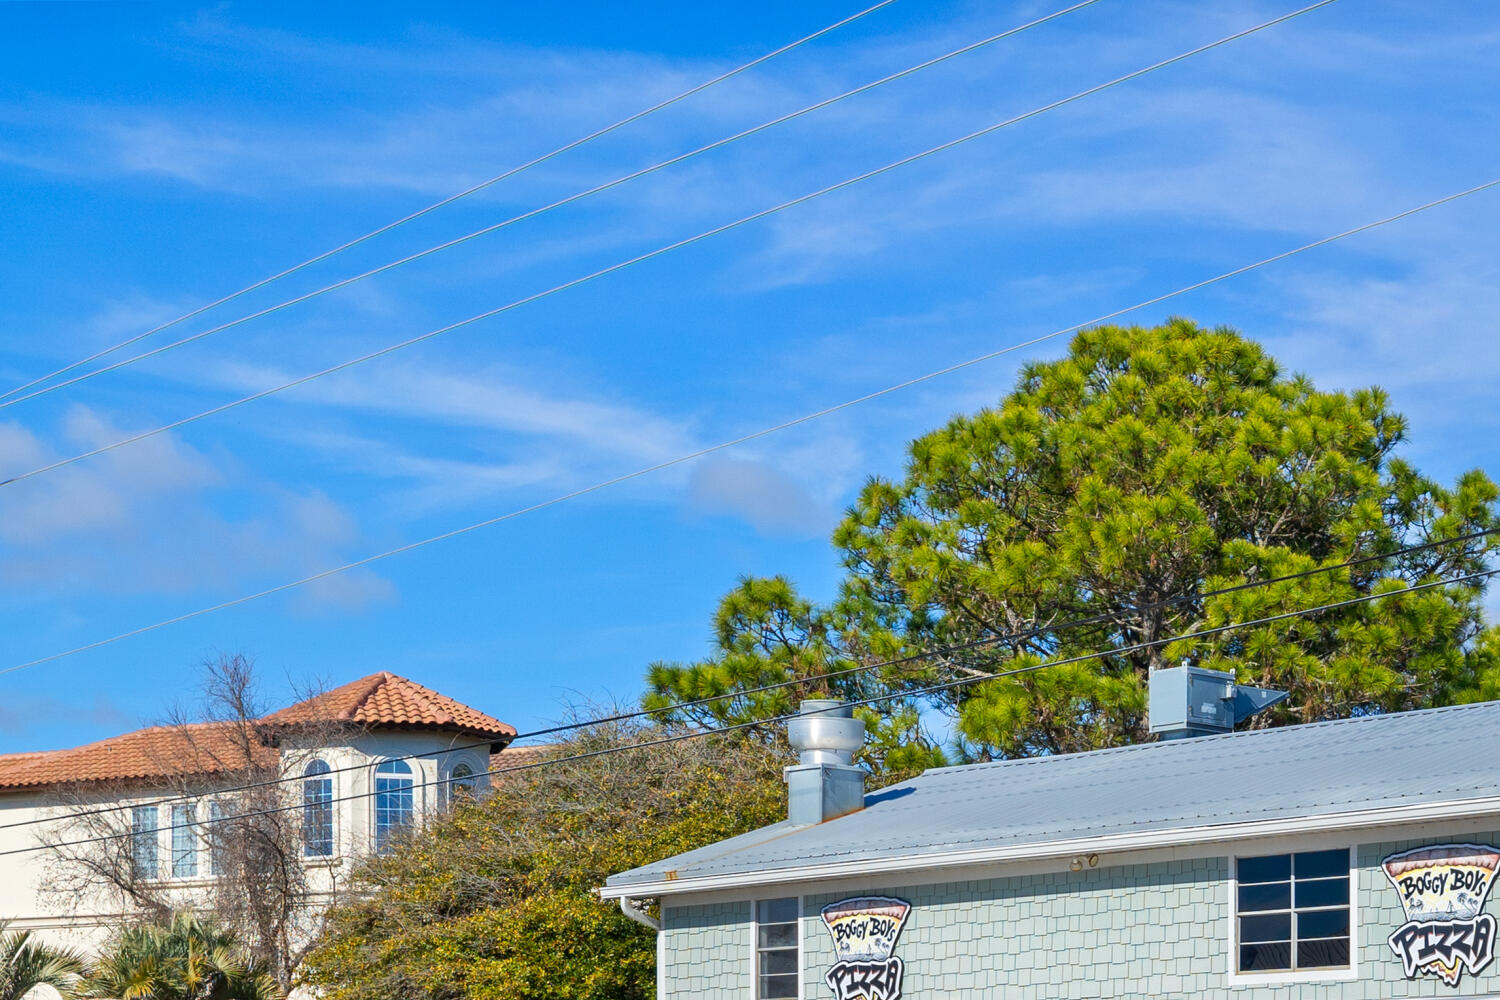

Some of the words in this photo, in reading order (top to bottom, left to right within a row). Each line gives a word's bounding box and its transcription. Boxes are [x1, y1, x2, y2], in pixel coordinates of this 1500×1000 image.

[1399, 872, 1449, 900] BOGGY
[1450, 868, 1486, 897] BOYS
[833, 919, 869, 942] BOGGY
[869, 916, 896, 942] BOYS
[1391, 917, 1492, 970] PIZZA
